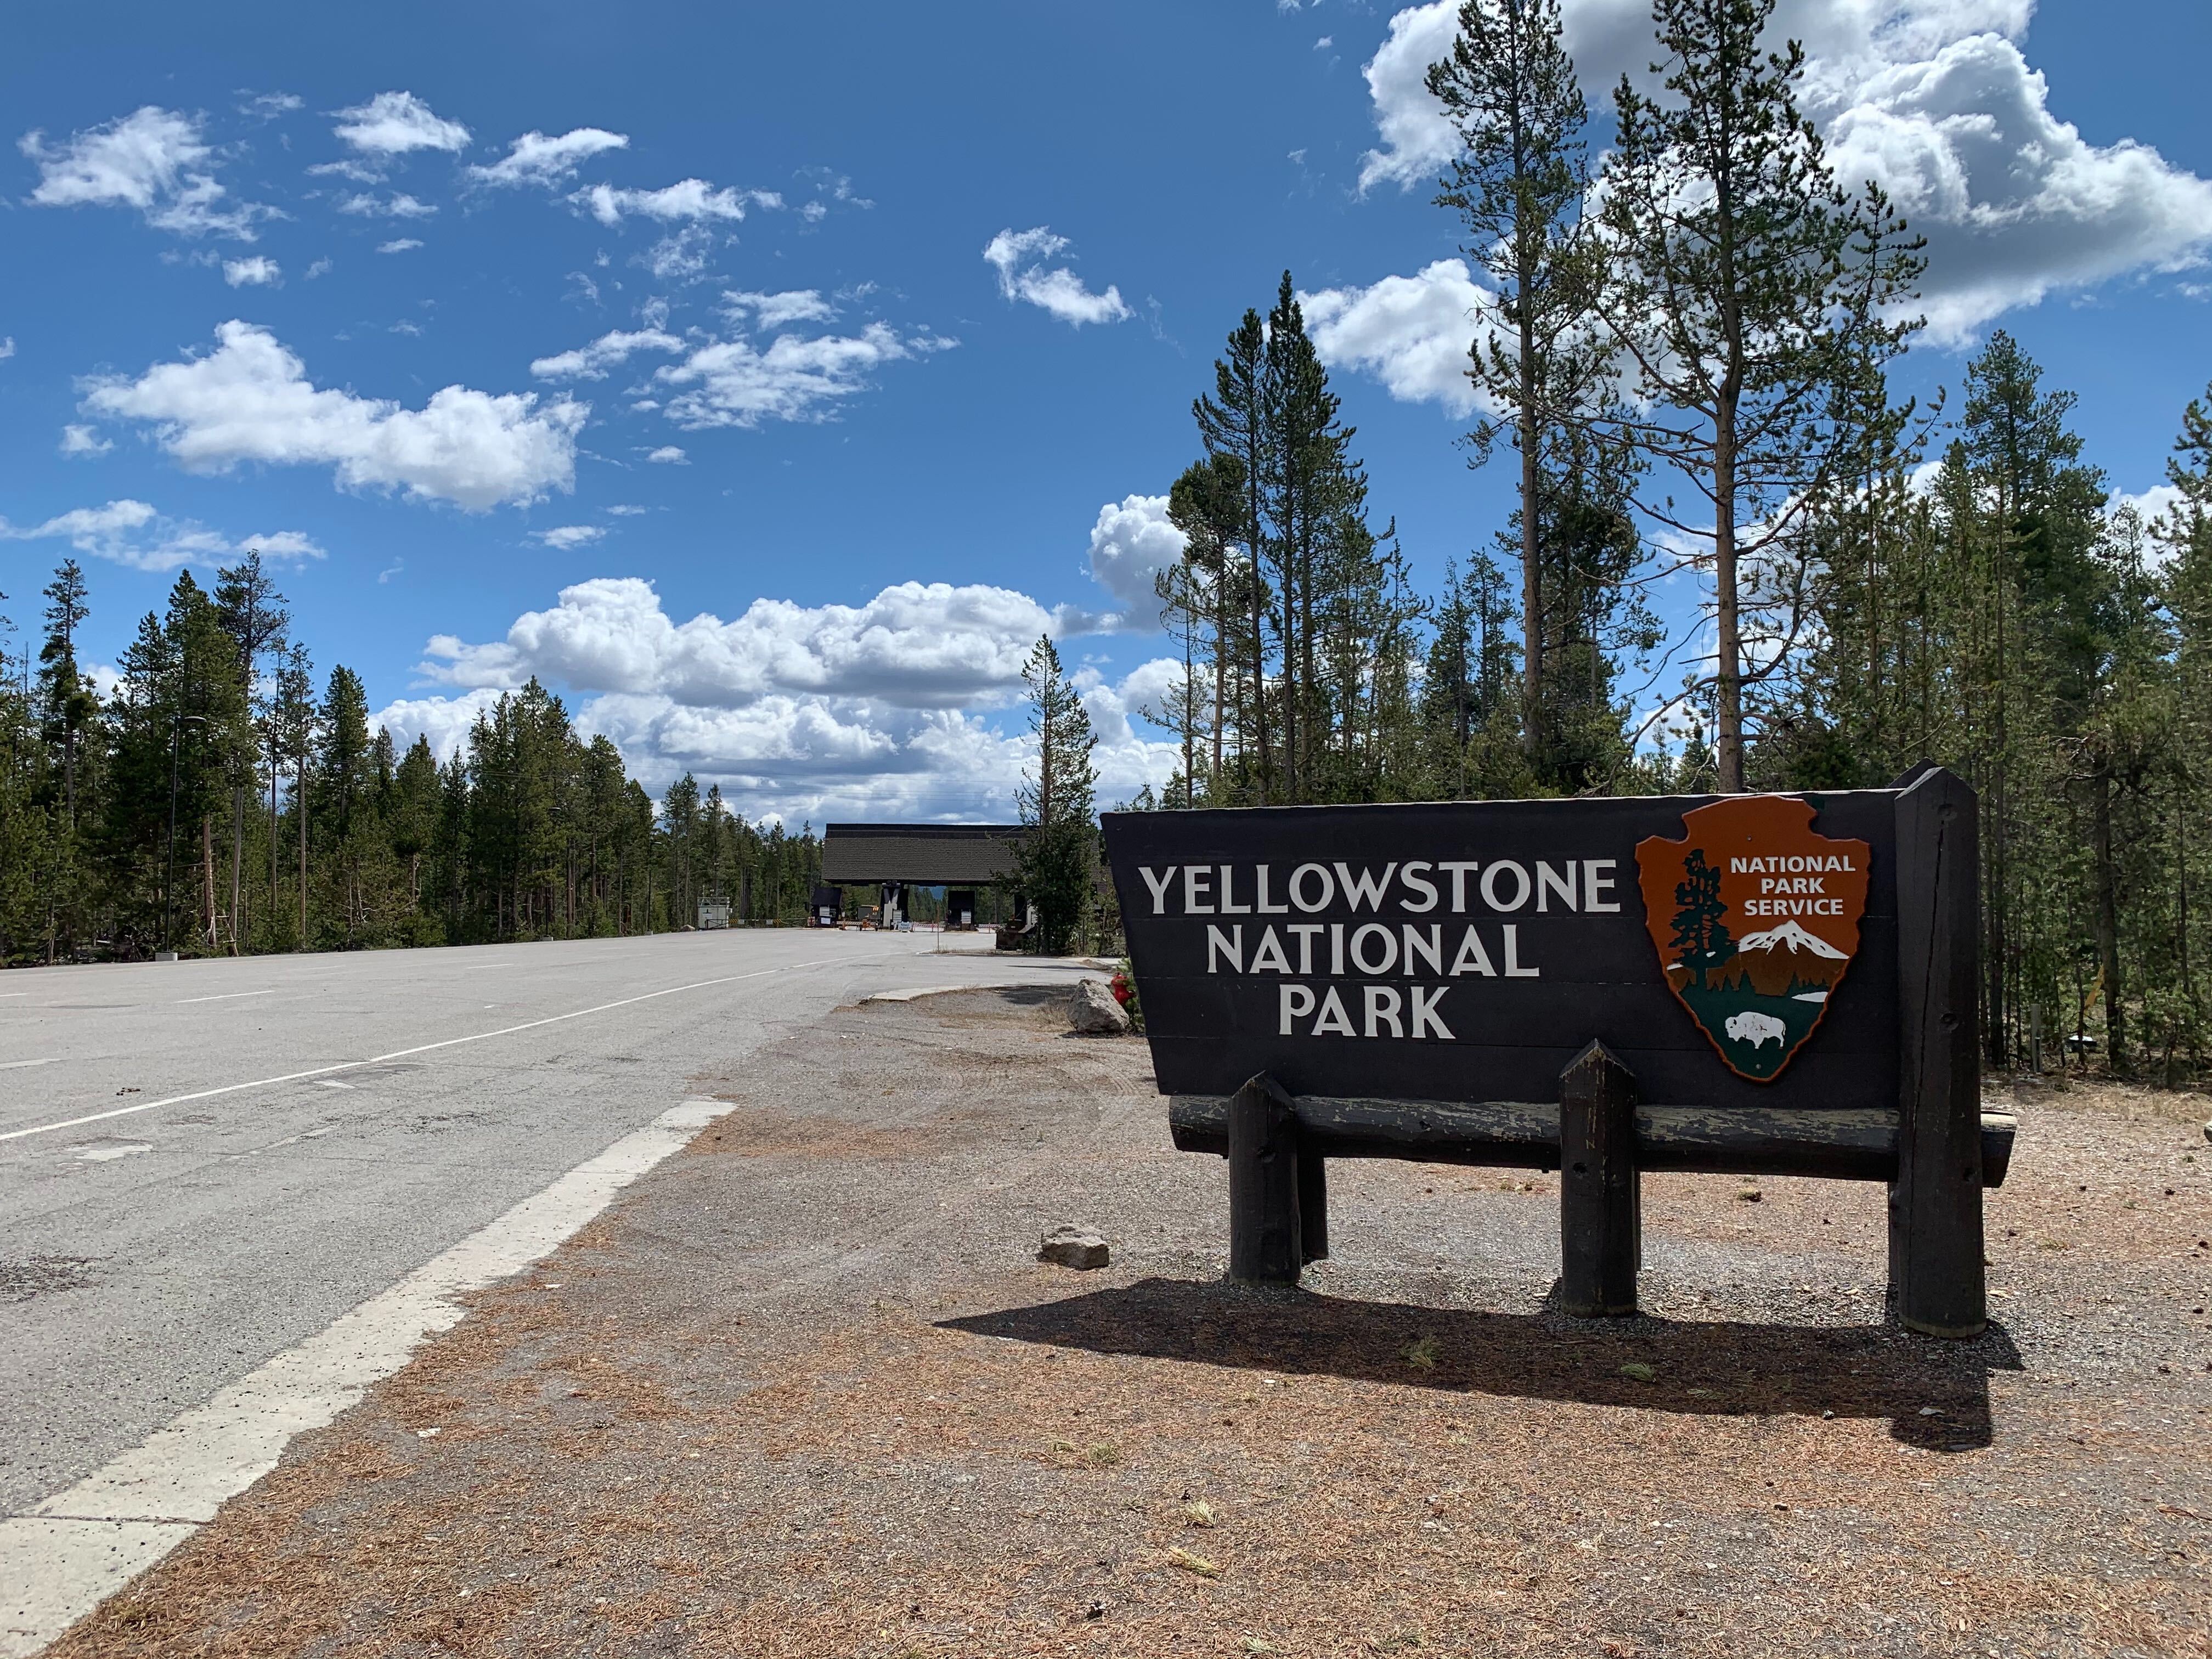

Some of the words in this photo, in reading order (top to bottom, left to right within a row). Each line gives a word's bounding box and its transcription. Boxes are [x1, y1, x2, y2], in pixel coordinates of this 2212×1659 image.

[1730, 855, 1857, 873] NATIONAL
[1138, 859, 1621, 914] YELLOWSTONE
[1761, 877, 1826, 894] PARK
[1745, 899, 1844, 916] SERVICE
[1206, 923, 1540, 977] NATIONAL
[1279, 984, 1456, 1040] PARK
